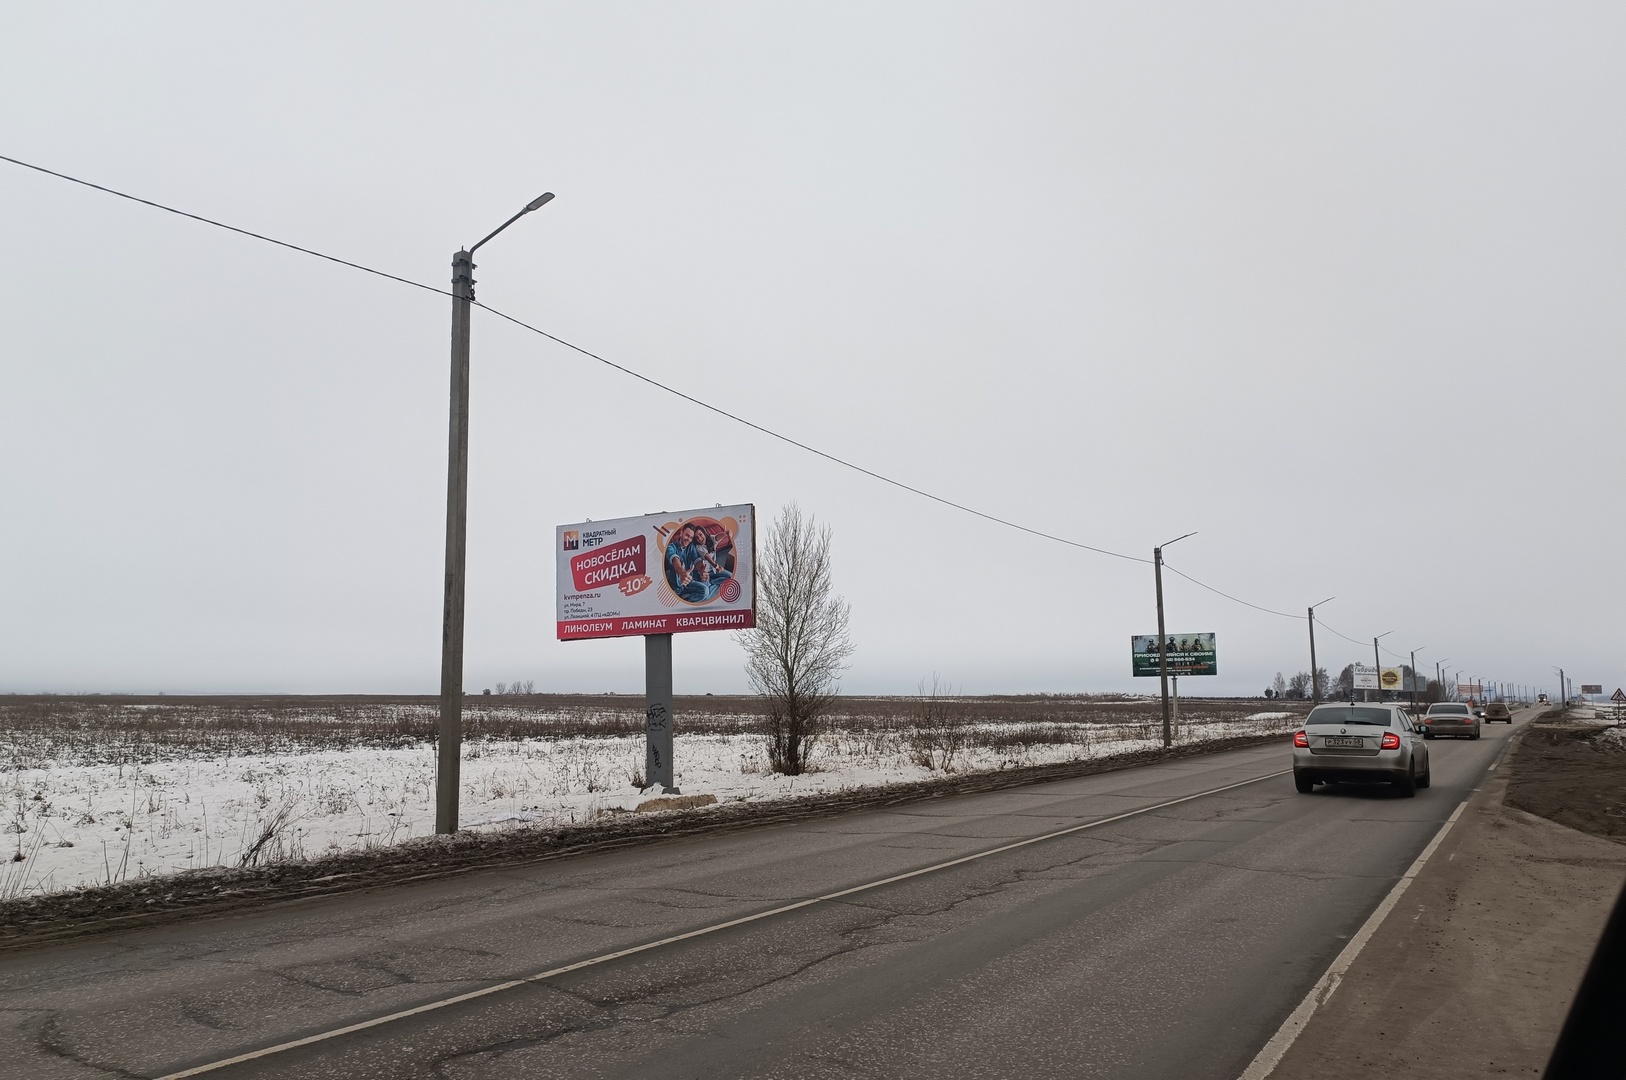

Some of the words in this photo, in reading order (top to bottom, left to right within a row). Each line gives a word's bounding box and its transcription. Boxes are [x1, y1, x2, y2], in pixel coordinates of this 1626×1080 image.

[583, 528, 616, 538] КВАДРАТНЫЙ
[583, 537, 603, 547] МЕТР
[576, 544, 641, 571] НОВОСЁЛАМ
[584, 560, 637, 585] СКИДКА
[621, 577, 647, 593] -10%
[563, 592, 601, 601] kvmpenza.ru
[621, 619, 667, 630] ЛАМИНАТ
[676, 614, 745, 627] КВАРЦВИНИЛ
[564, 622, 613, 634] ЛИНОЛЕУМ
